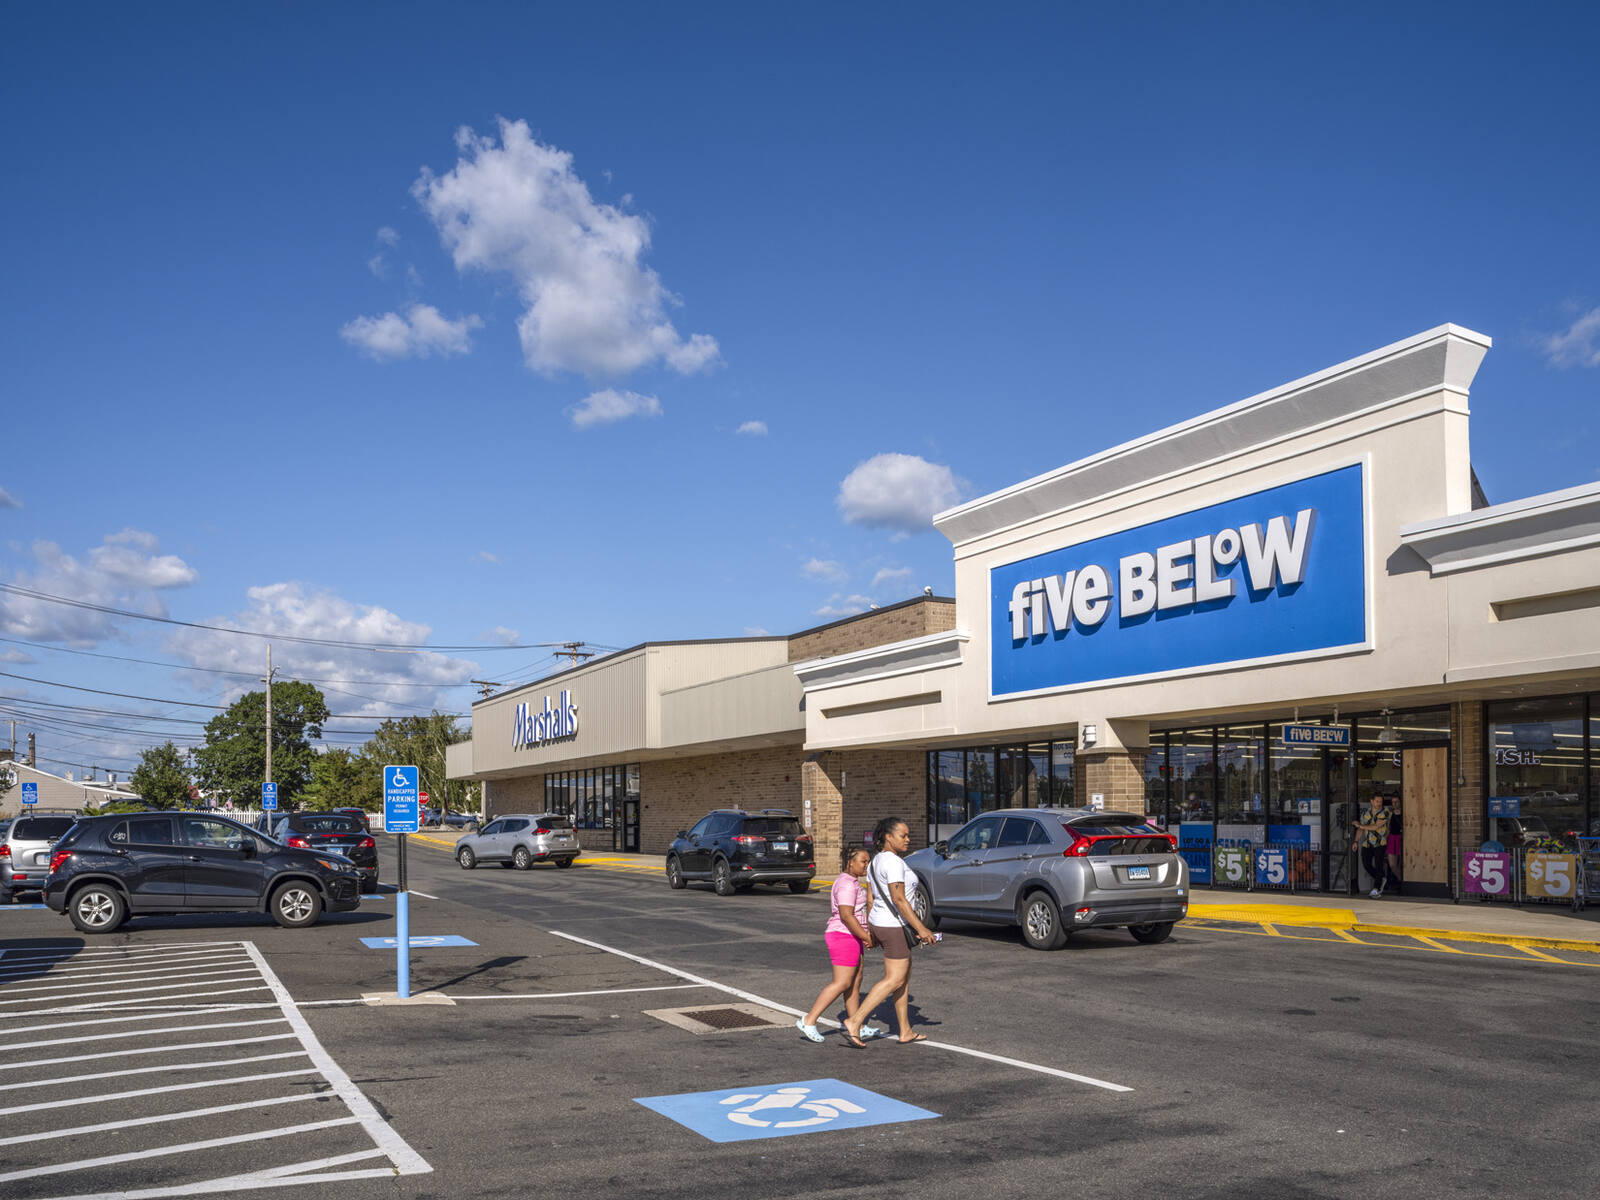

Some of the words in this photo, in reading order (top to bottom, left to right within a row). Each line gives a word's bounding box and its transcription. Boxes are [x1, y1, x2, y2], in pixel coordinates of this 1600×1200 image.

[1119, 508, 1316, 618] BELOW
[511, 689, 578, 747] Marshalls
[1313, 729, 1344, 742] BELOW
[387, 795, 416, 803] PARKING
[1217, 852, 1243, 881] $5
[1258, 853, 1285, 884] $5
[1468, 858, 1505, 894] $5
[1530, 860, 1571, 897] $5
